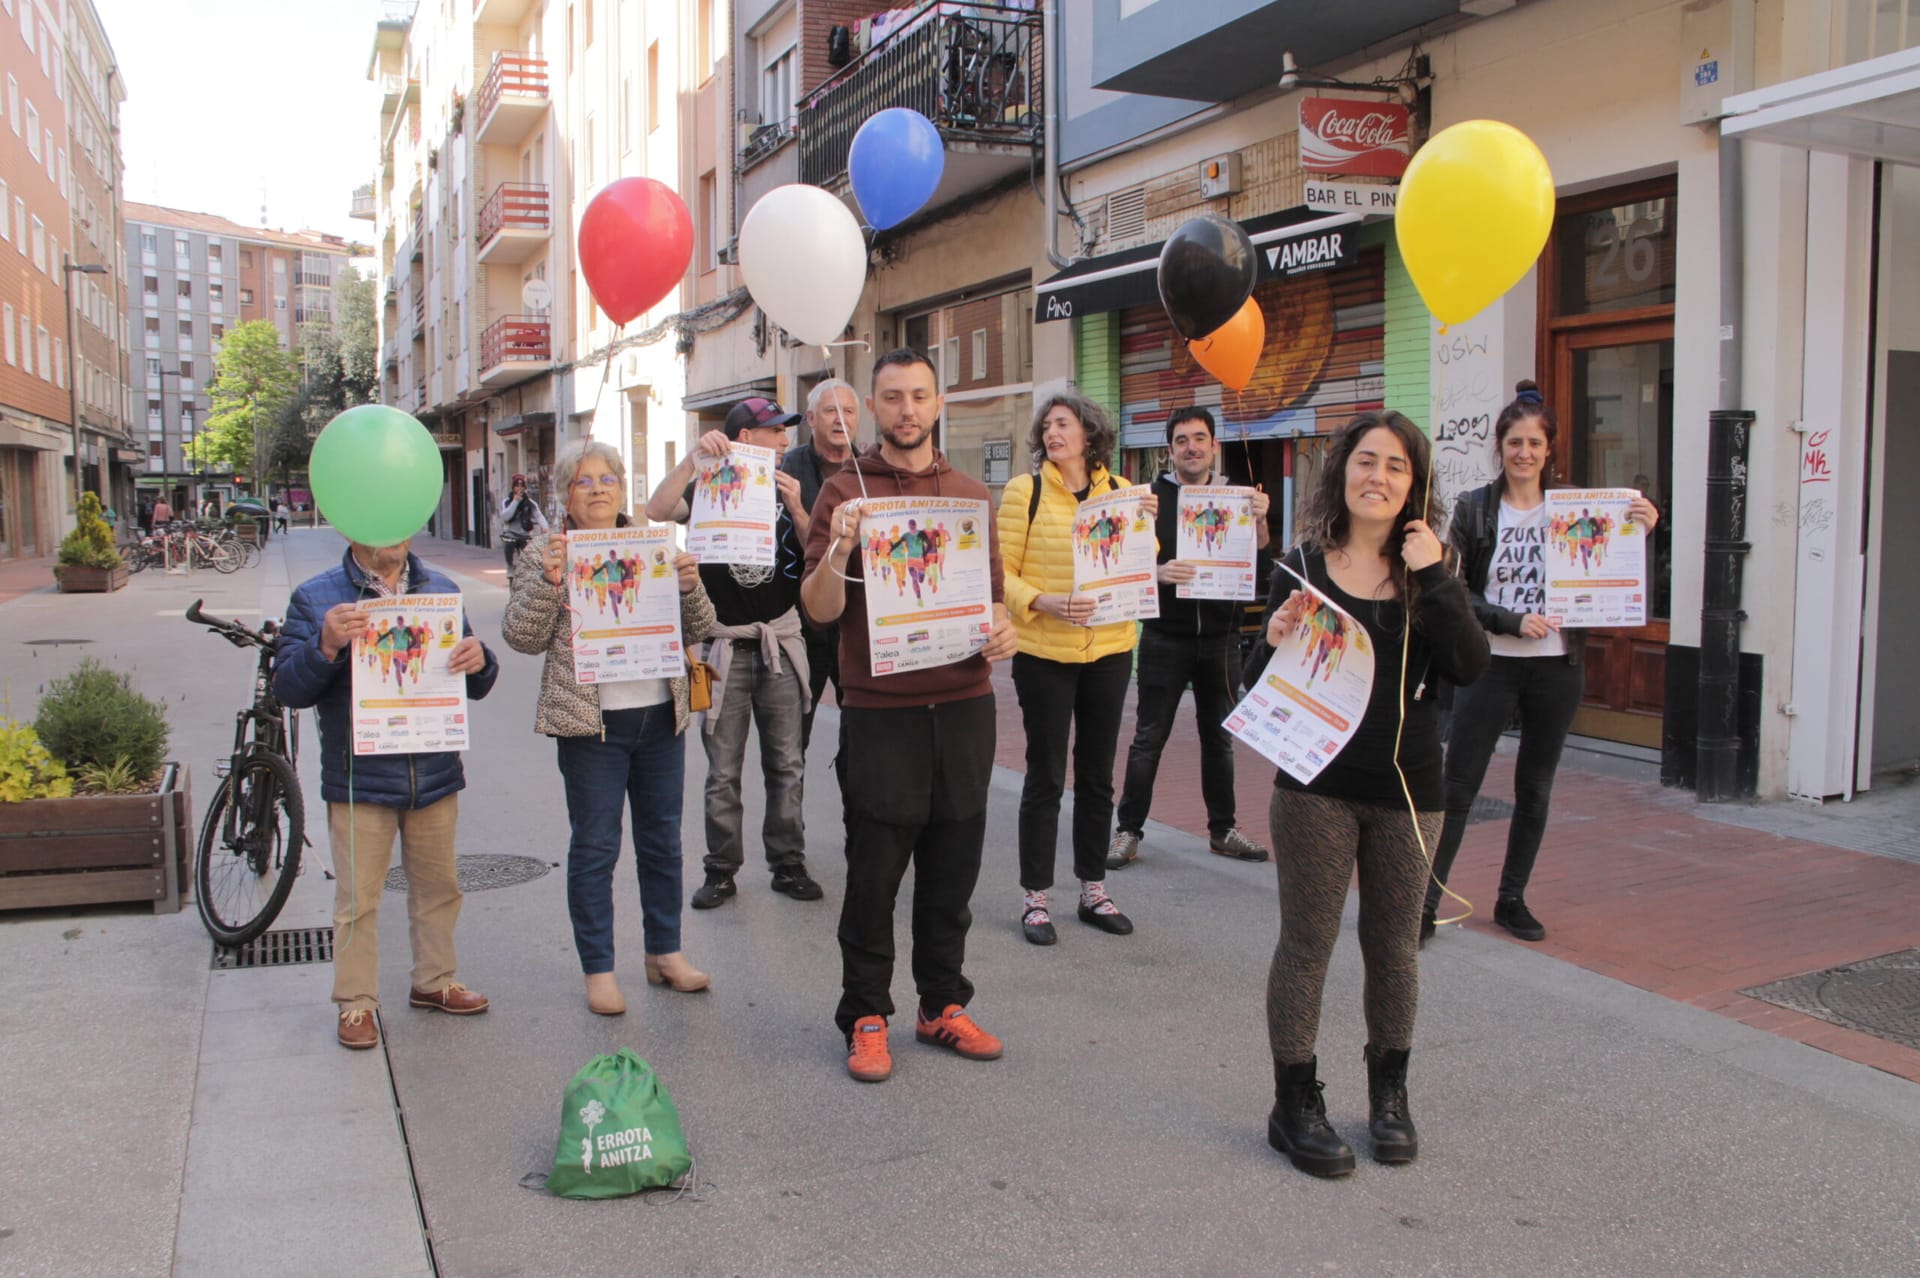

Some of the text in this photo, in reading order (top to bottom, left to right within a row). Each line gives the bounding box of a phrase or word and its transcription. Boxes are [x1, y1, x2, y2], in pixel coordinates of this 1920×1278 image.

[1318, 109, 1397, 145] Coca-Cola
[1307, 188, 1396, 207] BAR EL PIN
[1280, 233, 1343, 270] AMBAR
[1593, 222, 1655, 285] 26
[871, 499, 980, 512] RROTA ANITZA 2025
[573, 529, 670, 542] ERROTA ANITZA 2025
[1497, 565, 1545, 584] EKA
[400, 597, 435, 606] ANITZA
[597, 1127, 653, 1151] ERROTA
[600, 1144, 653, 1168] ANITZA
